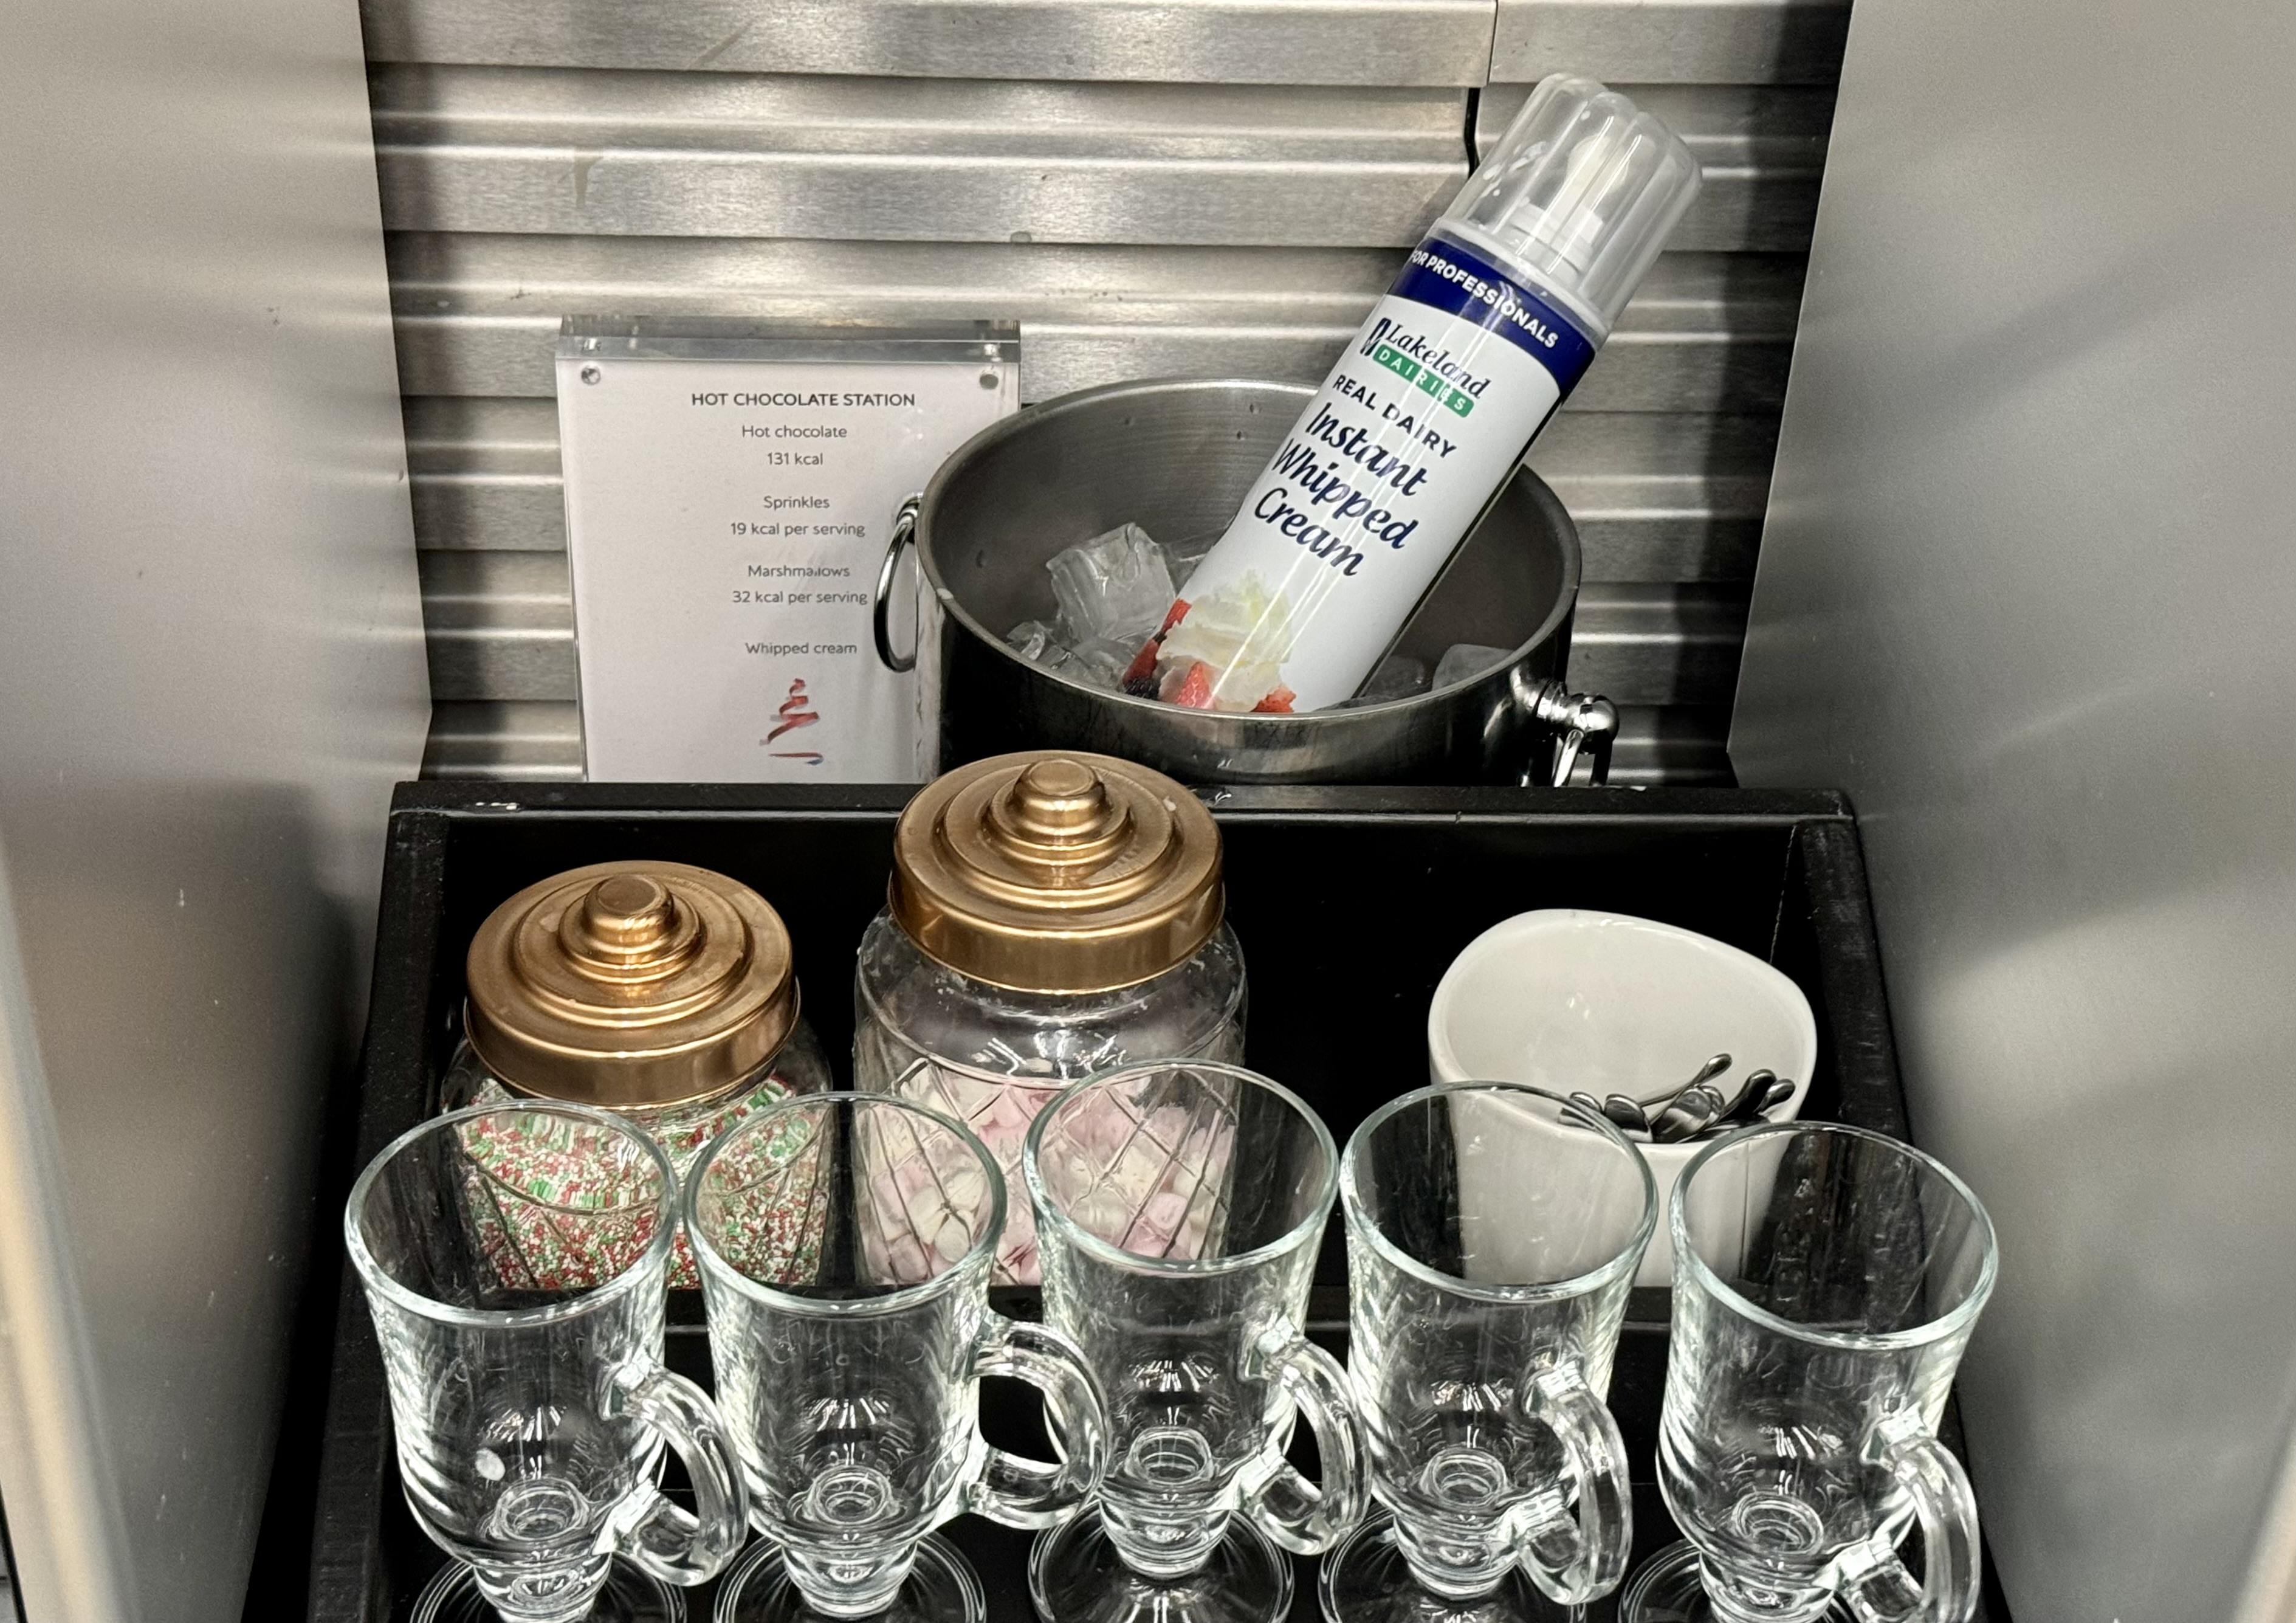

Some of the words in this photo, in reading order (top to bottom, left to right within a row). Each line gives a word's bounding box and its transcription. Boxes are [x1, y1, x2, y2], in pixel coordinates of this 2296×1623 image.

[1425, 255, 1559, 348] PROFESSIONALS
[1378, 349, 1466, 411] DAIRIES
[1385, 323, 1492, 399] Lakeland
[692, 393, 729, 406] HOT
[733, 393, 839, 407] CHOCOLATE
[843, 393, 915, 407] STATION
[1332, 374, 1377, 410] REAL
[1381, 402, 1457, 458] DAIRY
[741, 425, 771, 438] Hot
[775, 425, 848, 438] chocolate
[1305, 402, 1428, 497] Instant
[767, 452, 789, 466] 131
[794, 452, 823, 466] kcal
[763, 495, 830, 511] Sprinkles
[1271, 437, 1419, 550] Whipped
[730, 522, 746, 535] 19
[751, 522, 780, 535] kcal
[784, 524, 809, 538] per
[813, 523, 865, 537] serving
[1254, 488, 1364, 577] Cream
[732, 590, 751, 603] 32
[755, 591, 783, 603] kcal
[788, 592, 813, 605] per
[816, 591, 868, 605] serving
[745, 643, 809, 656] Whipped
[813, 644, 858, 655] cream
